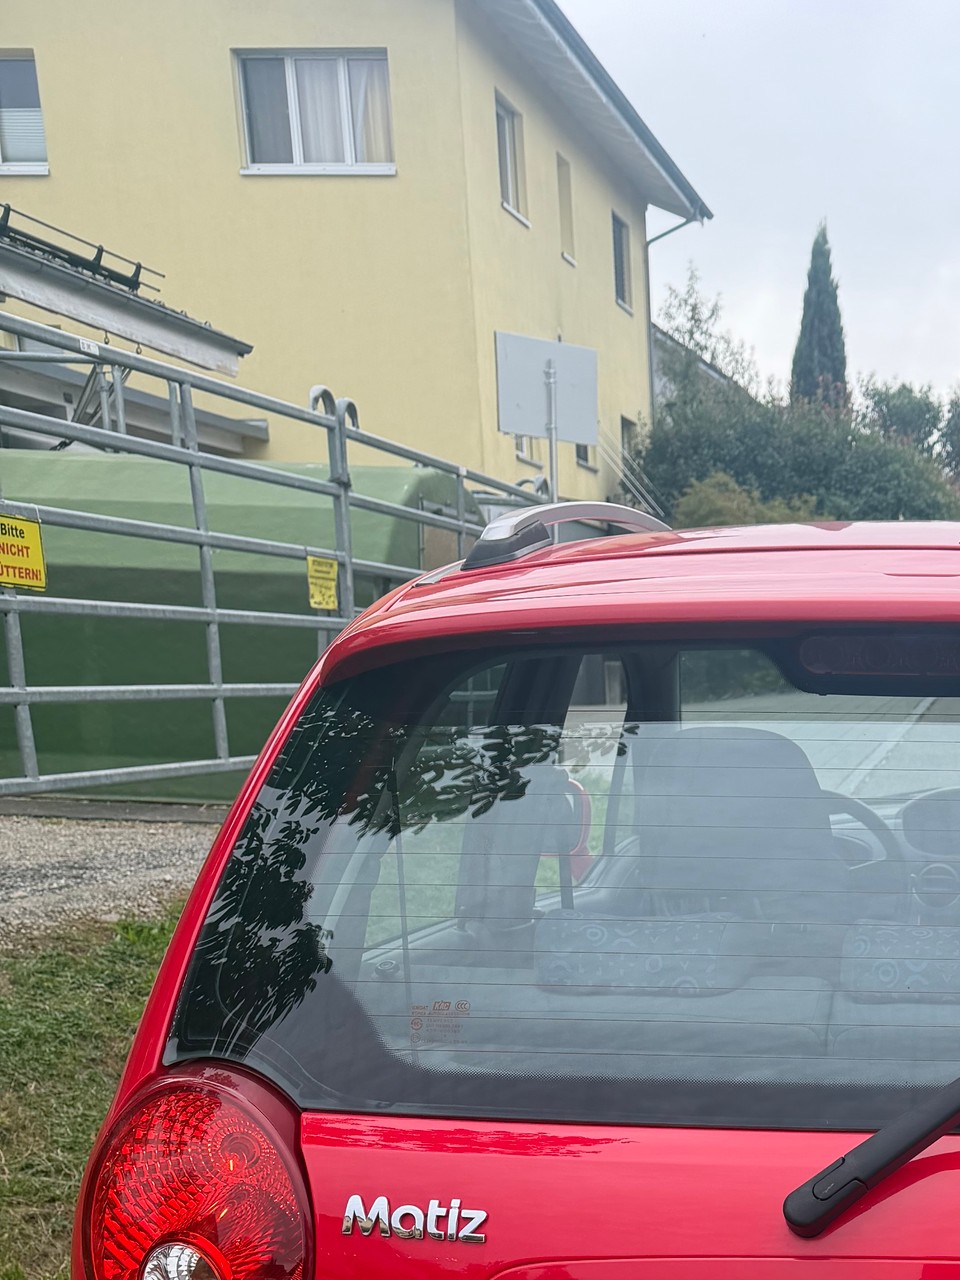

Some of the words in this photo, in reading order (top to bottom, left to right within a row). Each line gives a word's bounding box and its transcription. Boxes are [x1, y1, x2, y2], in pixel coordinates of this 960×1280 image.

[0, 523, 25, 539] Bitte
[0, 542, 30, 558] NICHT
[341, 1194, 488, 1243] Matiz
